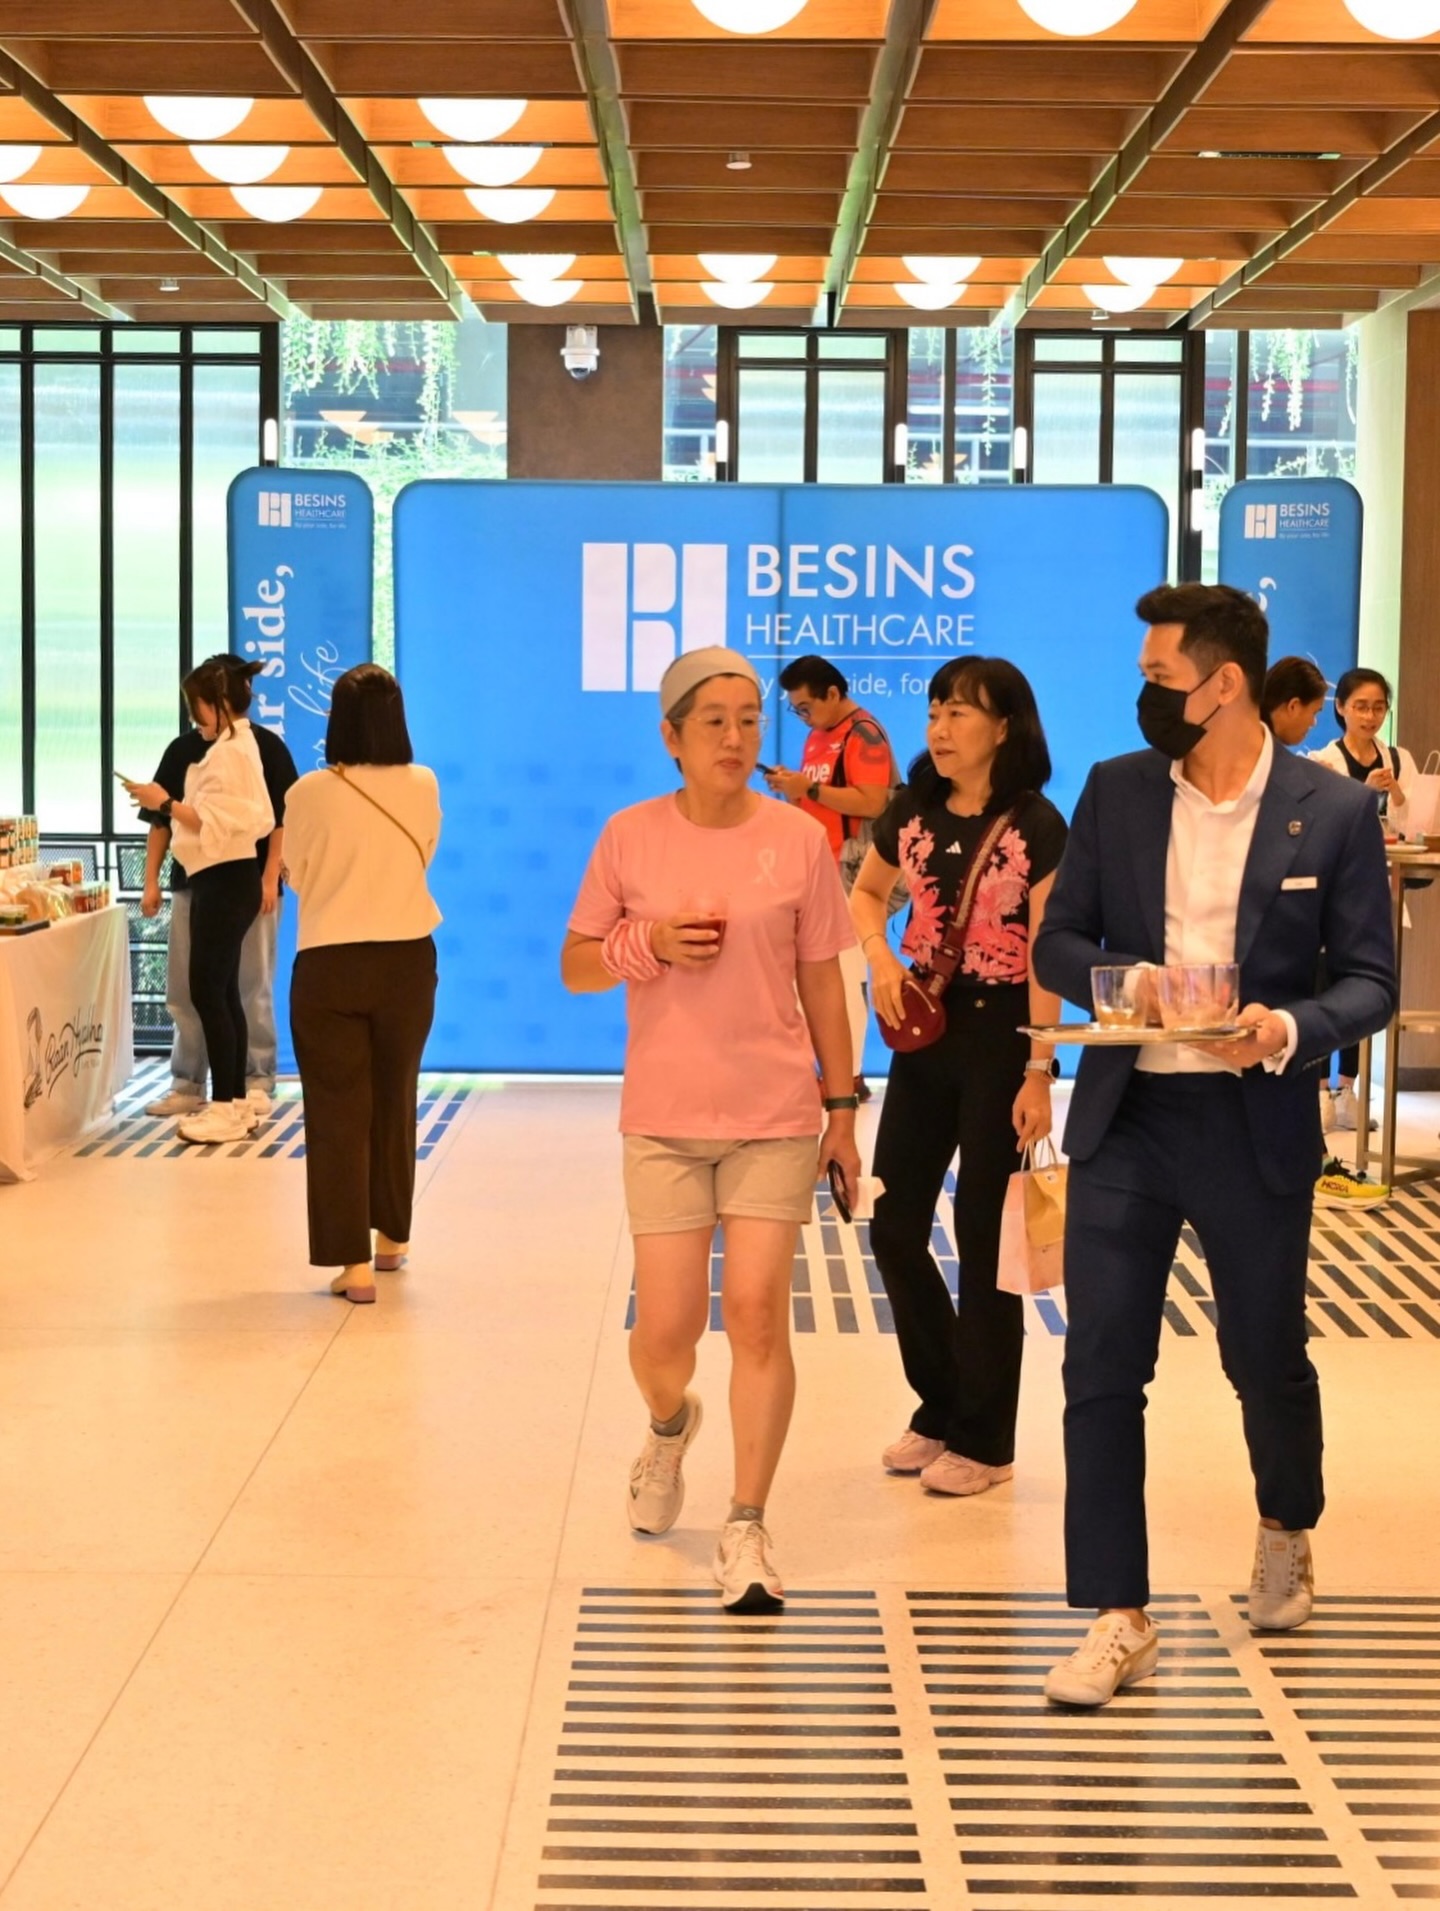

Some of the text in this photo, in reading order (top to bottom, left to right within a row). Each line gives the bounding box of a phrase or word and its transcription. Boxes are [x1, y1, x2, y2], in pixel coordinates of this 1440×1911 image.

[295, 493, 346, 508] BESINS
[1280, 503, 1330, 517] BESINS
[747, 544, 975, 599] BESINS
[746, 613, 974, 647] HEALTHCARE
